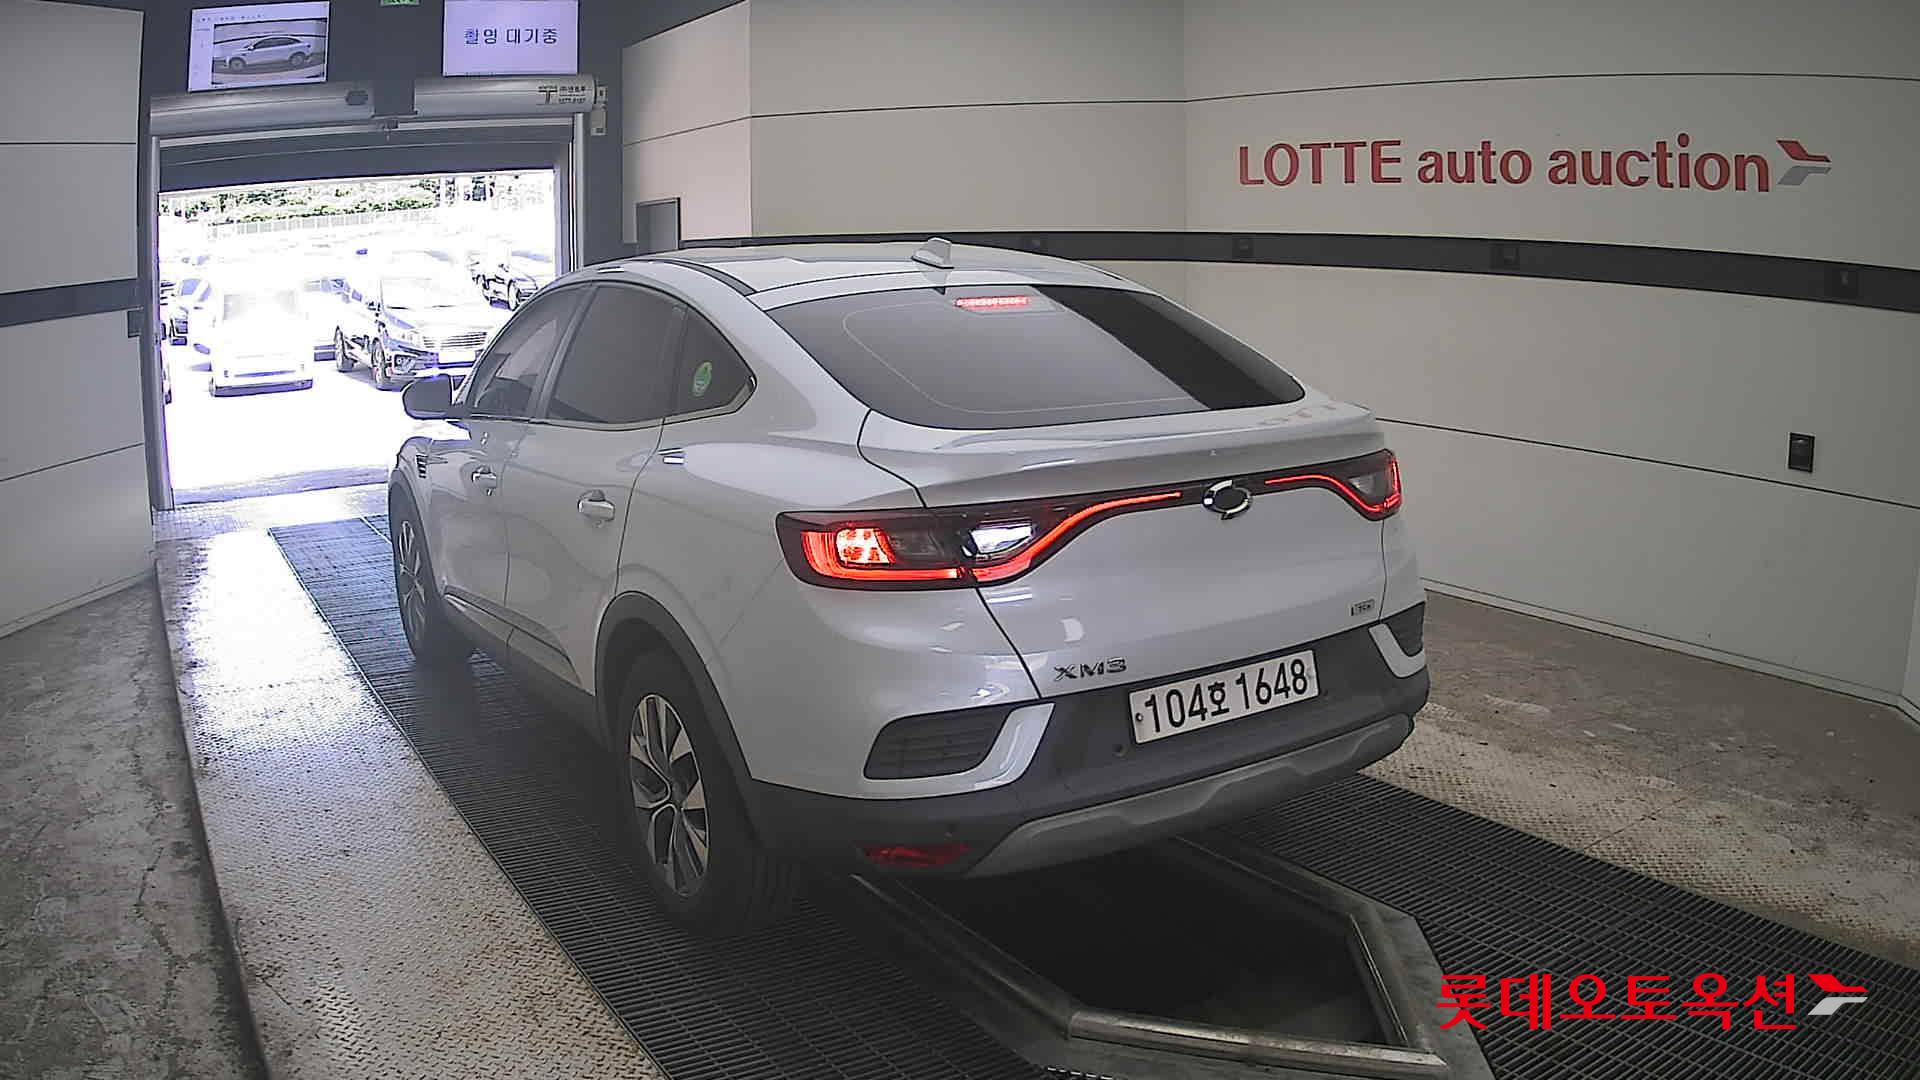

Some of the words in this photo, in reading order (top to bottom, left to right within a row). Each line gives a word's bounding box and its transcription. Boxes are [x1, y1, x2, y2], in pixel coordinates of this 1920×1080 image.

[506, 27, 558, 45] 대기중
[1238, 139, 1402, 187] LOTTE
[1417, 140, 1533, 186] auto
[1548, 133, 1771, 192] auction
[1054, 656, 1127, 681] XM3
[1145, 682, 1230, 733] 104호
[1235, 658, 1308, 710] 1648
